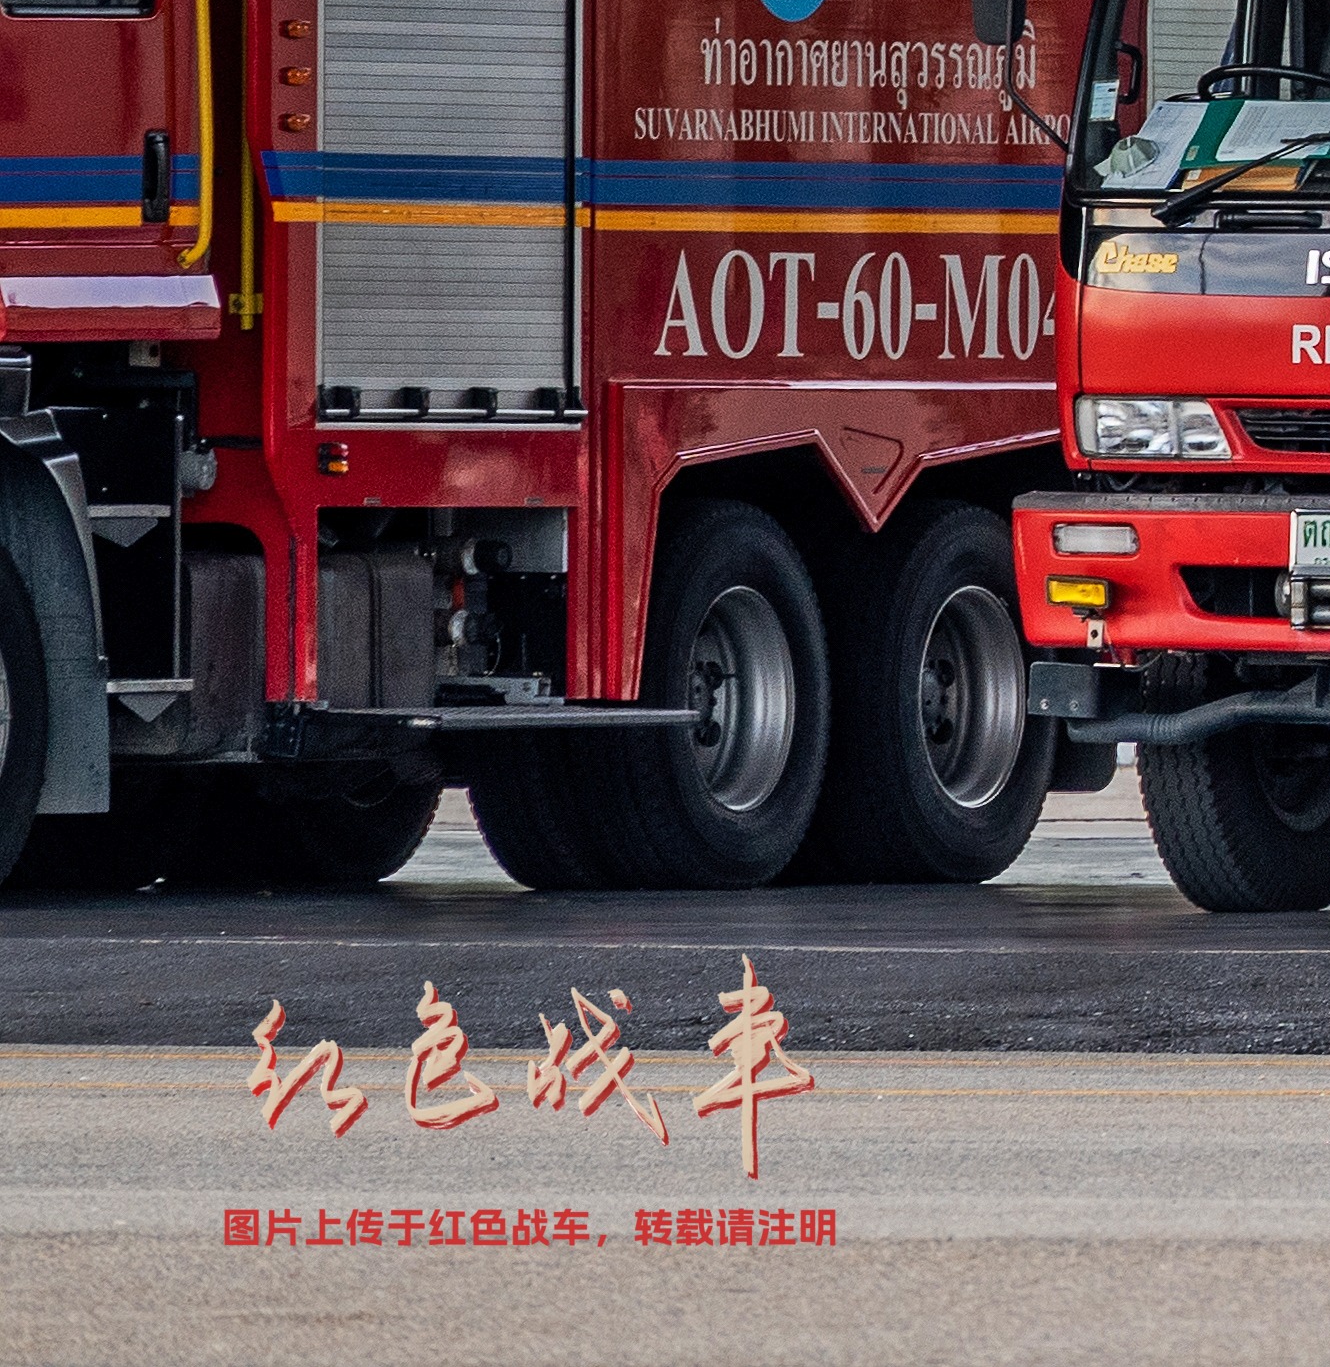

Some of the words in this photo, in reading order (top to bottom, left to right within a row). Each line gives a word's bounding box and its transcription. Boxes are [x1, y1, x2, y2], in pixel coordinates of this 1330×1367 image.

[634, 106, 816, 144] SUVARNABHUMI
[821, 109, 999, 146] INTERNATIONAL
[1096, 240, 1179, 274] Chase
